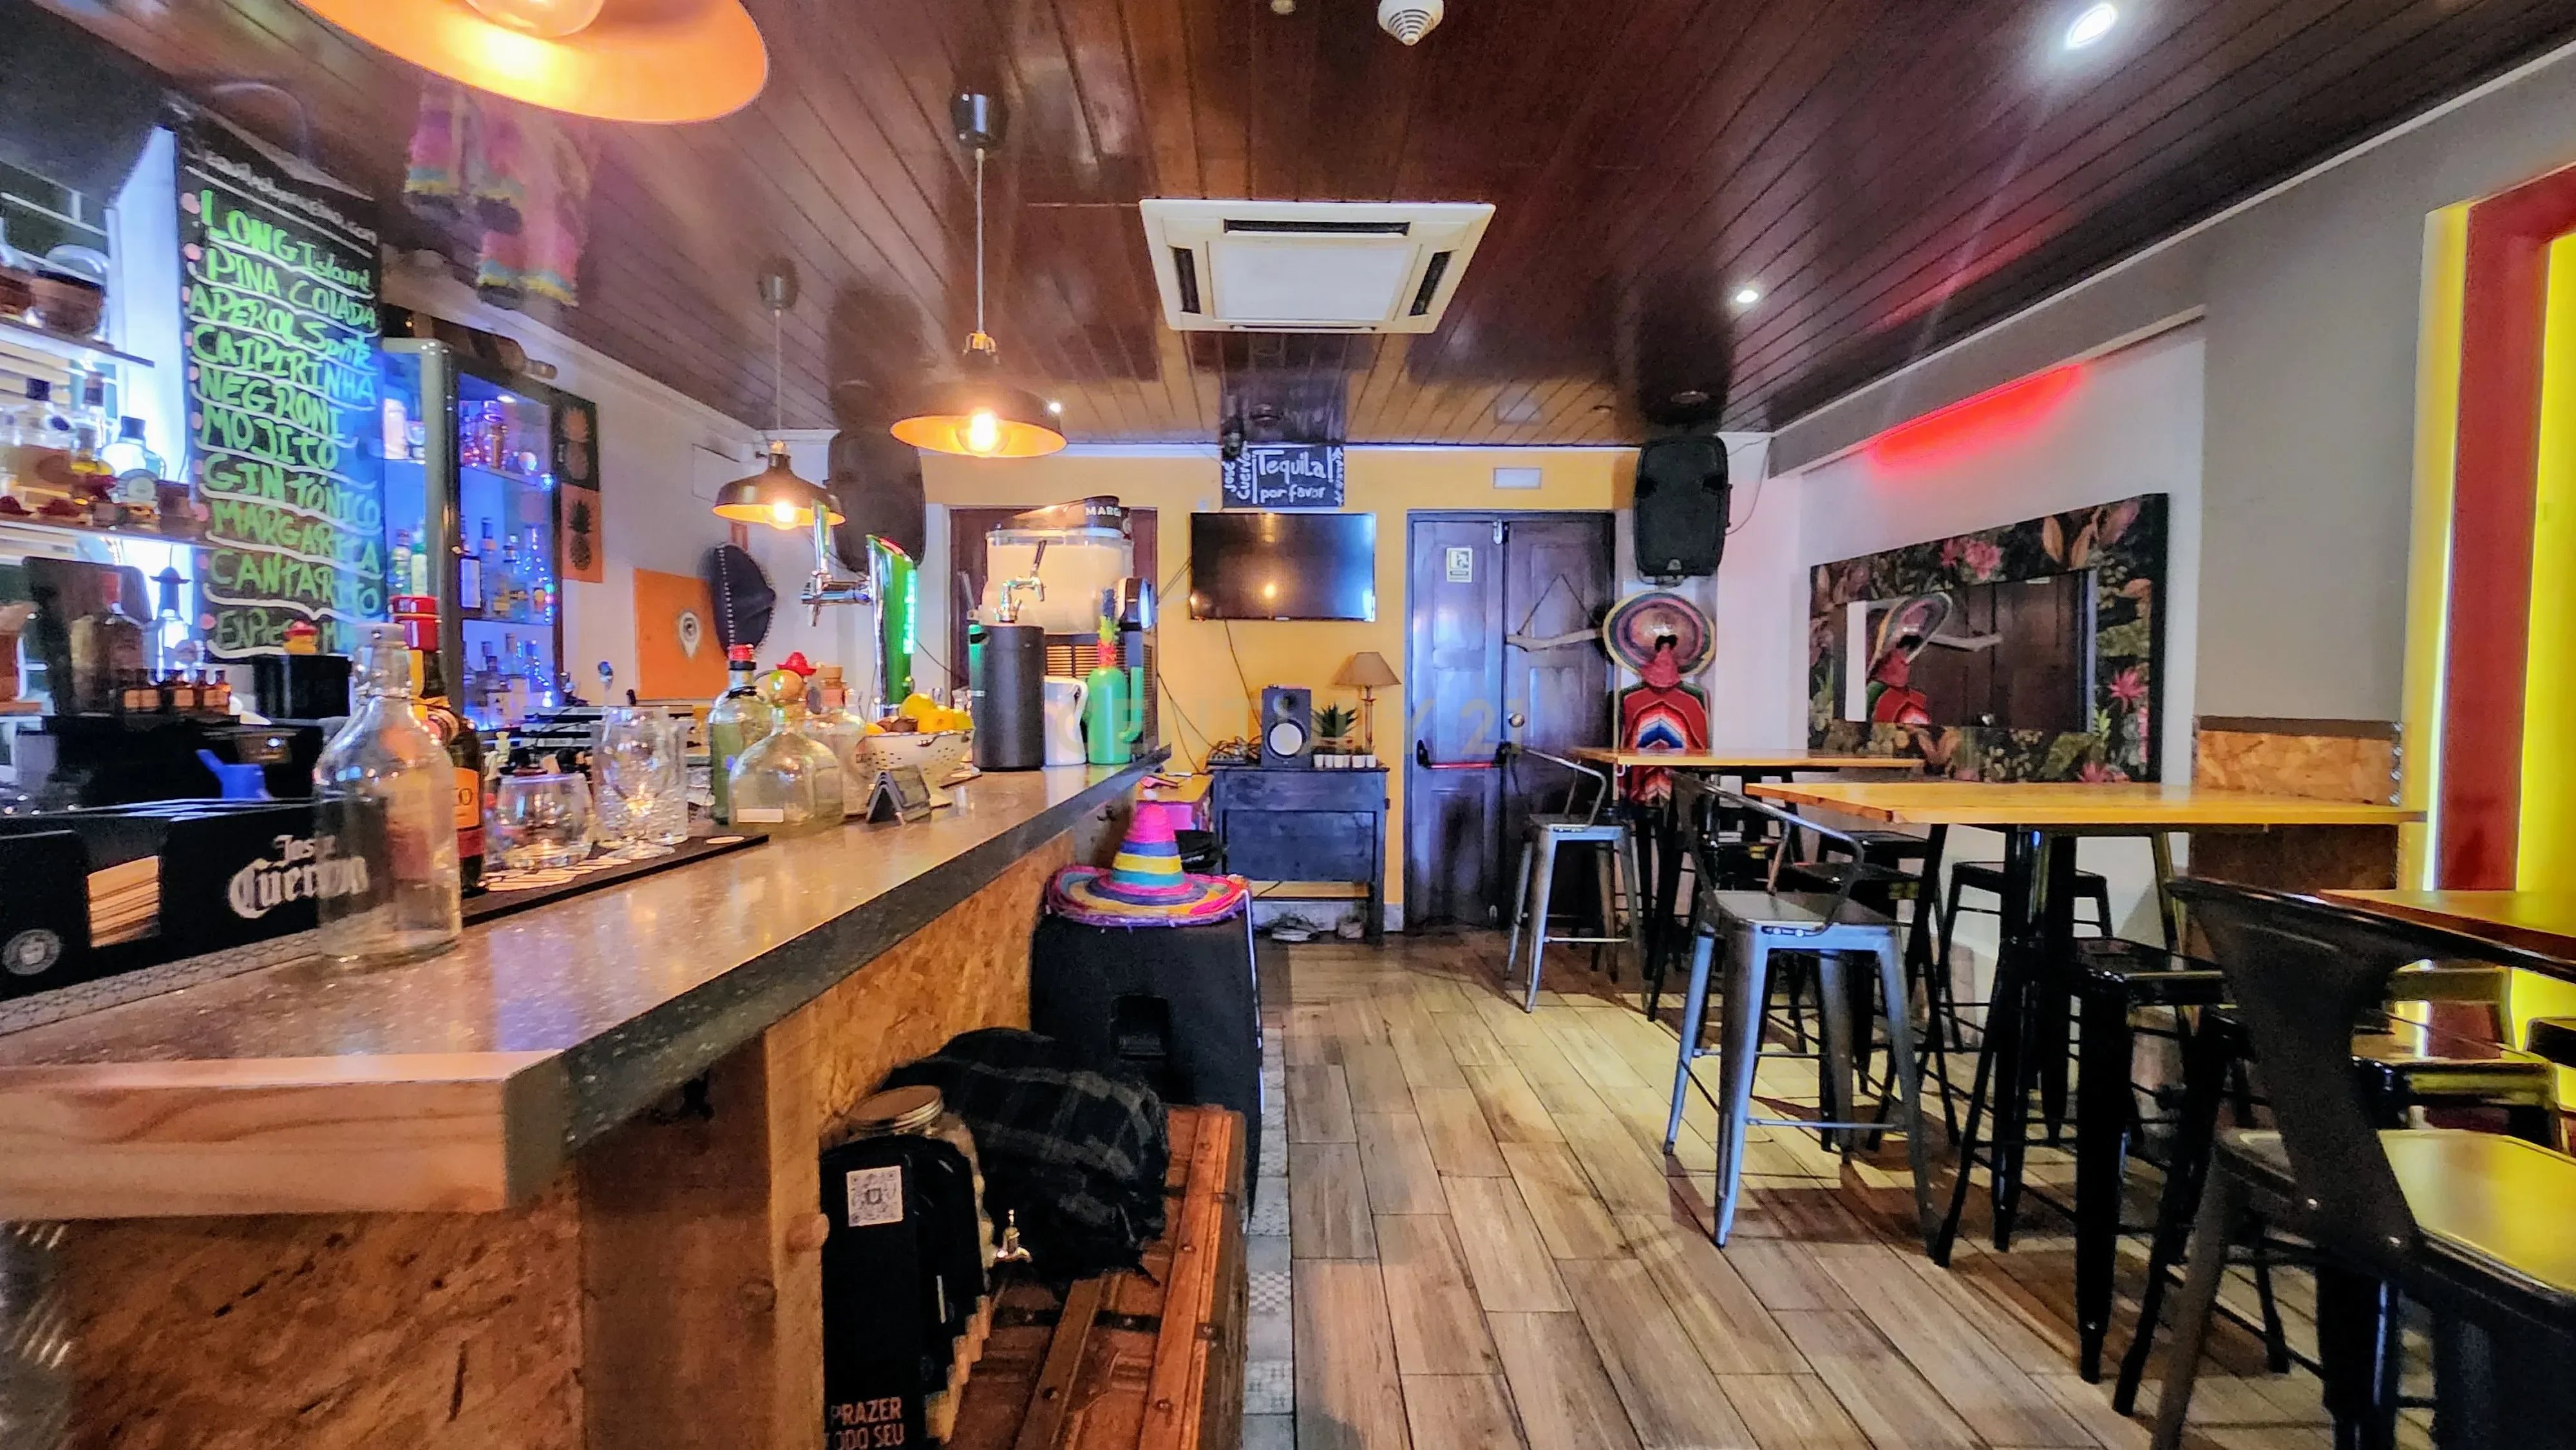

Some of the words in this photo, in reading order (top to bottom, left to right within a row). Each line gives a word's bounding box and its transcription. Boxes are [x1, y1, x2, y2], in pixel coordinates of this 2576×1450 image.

[200, 189, 299, 262] LONG
[190, 284, 304, 344] APEROL
[288, 280, 376, 330] COLADA
[192, 324, 377, 406] CAIPIRINHA
[200, 364, 346, 439] NEGRONI
[204, 452, 285, 501] GIN
[1260, 487, 1287, 504] por
[1289, 484, 1326, 503] favor
[830, 1396, 902, 1426] PRAZER
[874, 1422, 905, 1447] SEU
